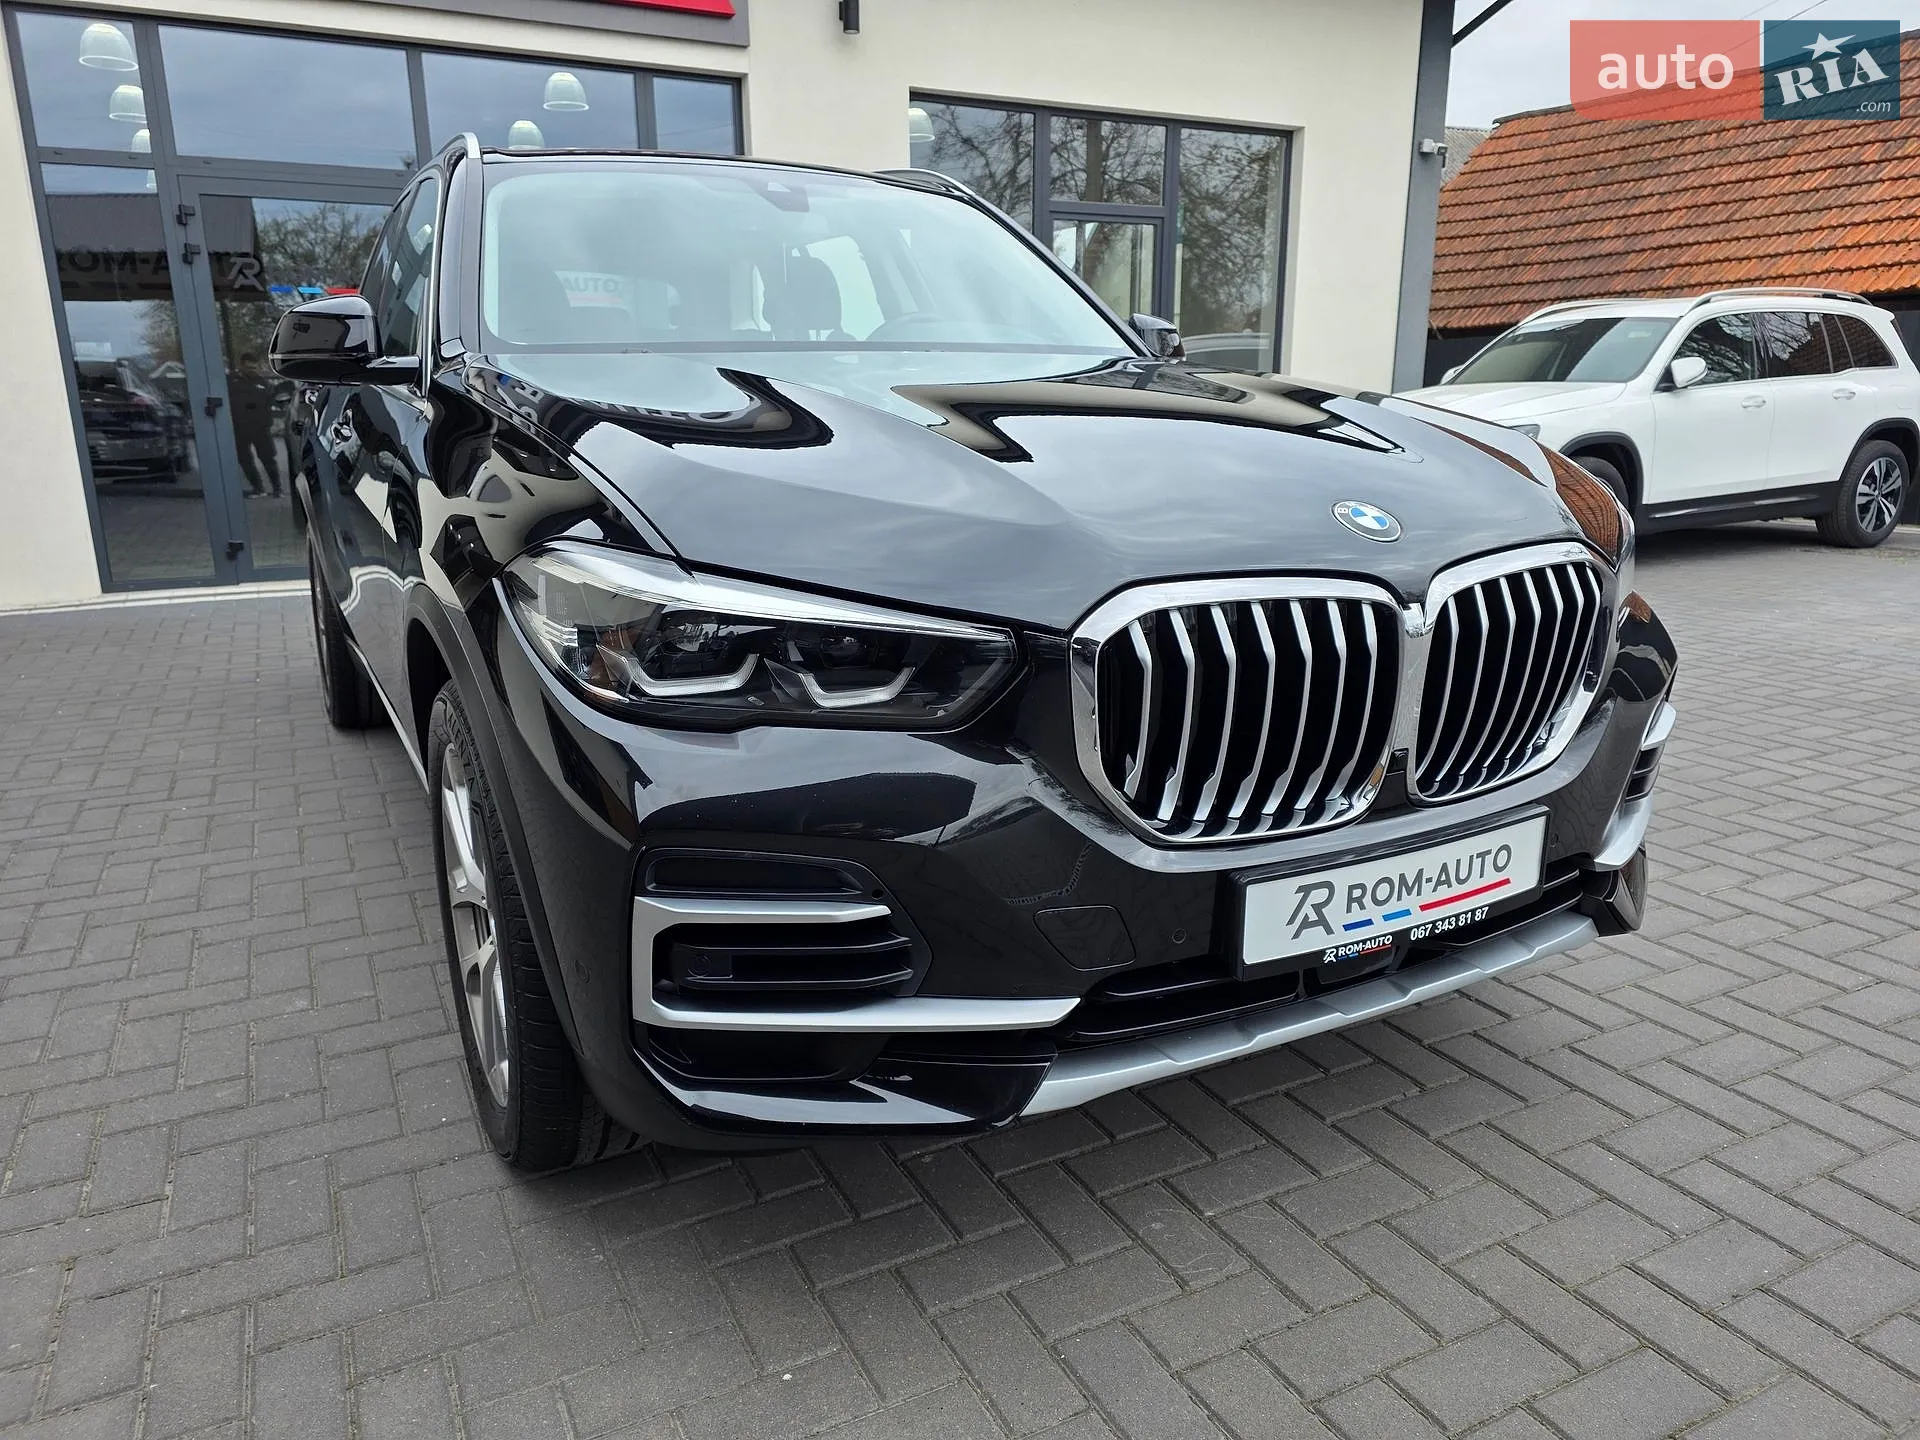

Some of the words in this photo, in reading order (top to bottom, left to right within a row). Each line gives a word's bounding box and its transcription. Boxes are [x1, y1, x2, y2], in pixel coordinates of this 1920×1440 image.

[1345, 843, 1513, 914] ROM-AUTO
[1410, 924, 1433, 941] 067
[1434, 916, 1456, 934] 343
[1458, 911, 1472, 927] 81
[1474, 906, 1489, 921] 87
[1338, 935, 1393, 957] ROM-AUTO
